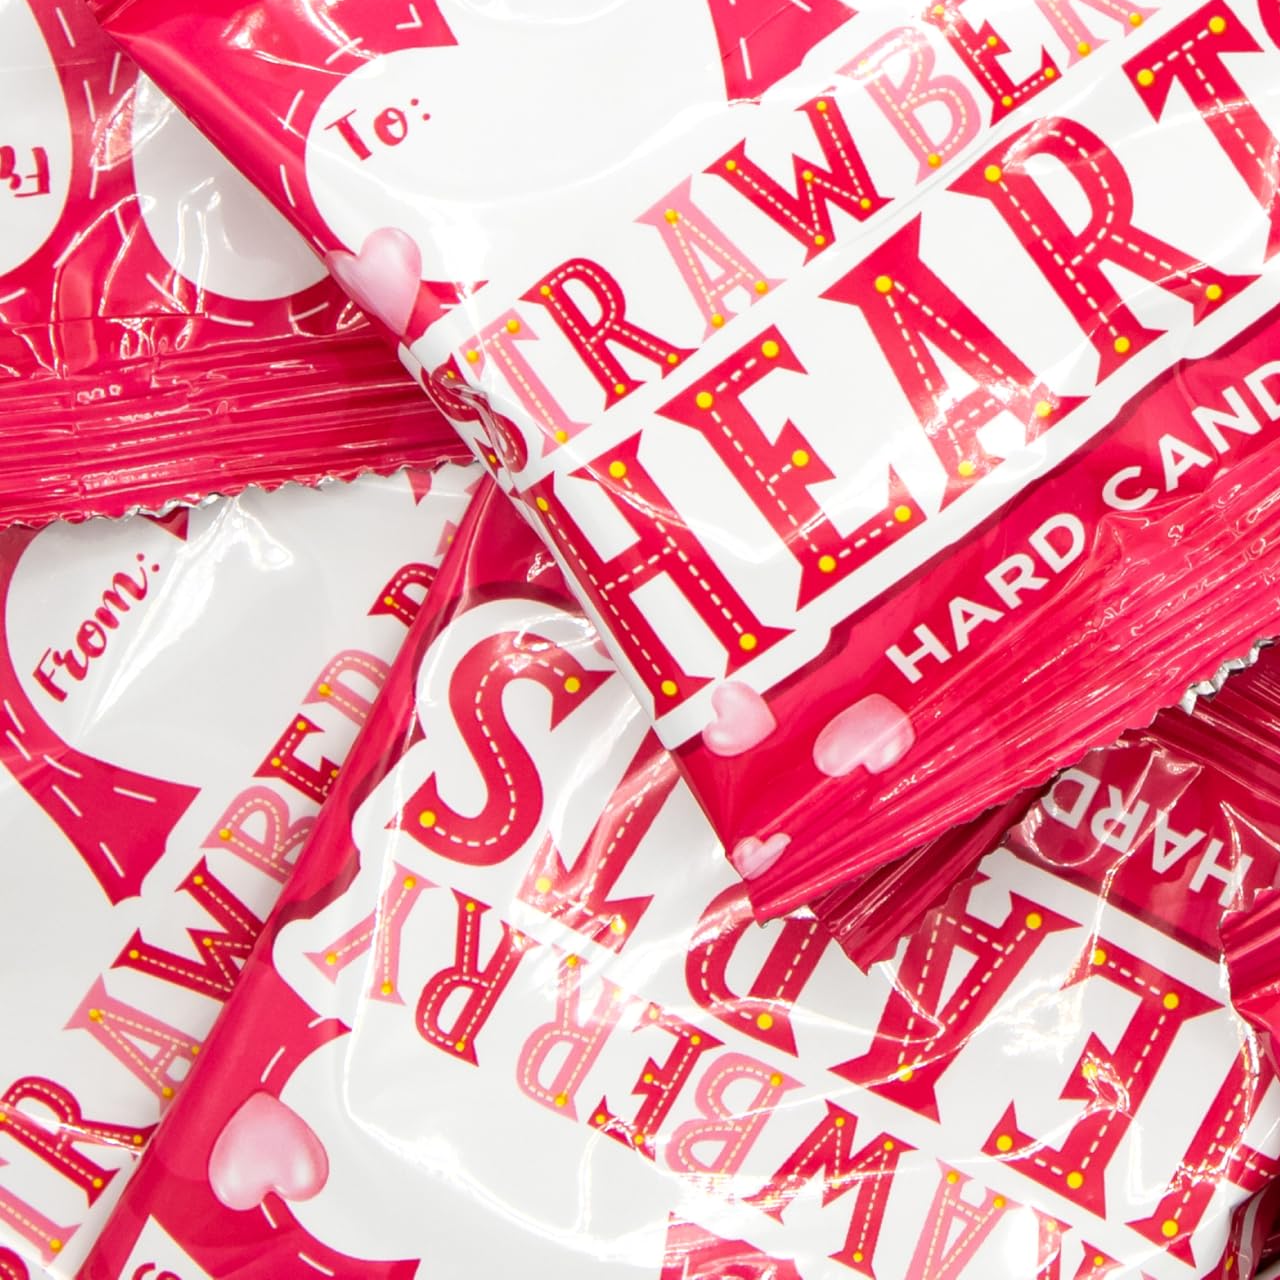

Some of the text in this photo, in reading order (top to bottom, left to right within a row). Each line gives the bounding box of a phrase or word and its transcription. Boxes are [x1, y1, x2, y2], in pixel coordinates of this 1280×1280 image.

[325, 97, 431, 162] To:
[32, 550, 161, 702] From:
[886, 512, 1086, 684] HARD
[1041, 769, 1253, 907] HARD
